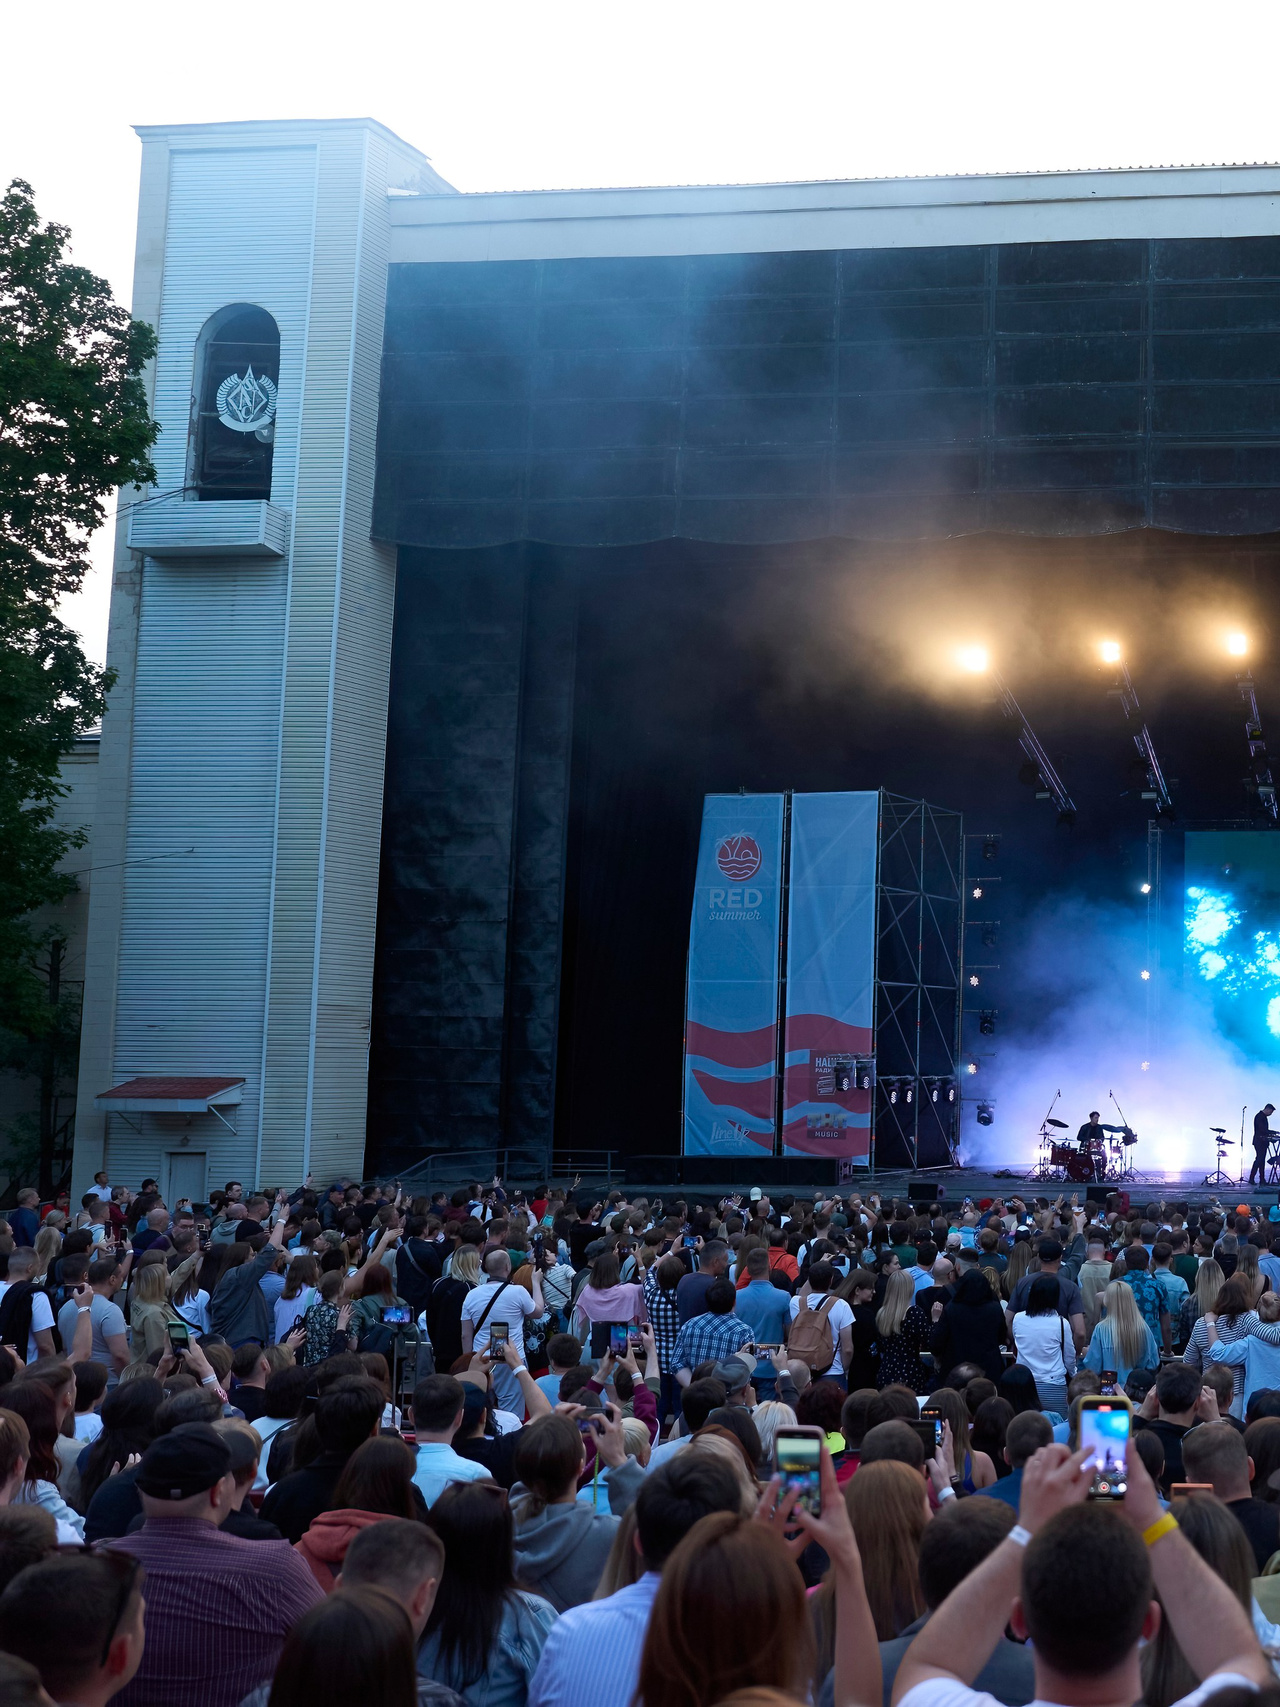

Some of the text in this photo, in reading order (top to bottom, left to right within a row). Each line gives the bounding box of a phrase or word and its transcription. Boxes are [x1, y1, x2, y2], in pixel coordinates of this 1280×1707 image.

[709, 888, 763, 909] RED
[708, 909, 762, 921] summer
[815, 1057, 842, 1067] НАШ
